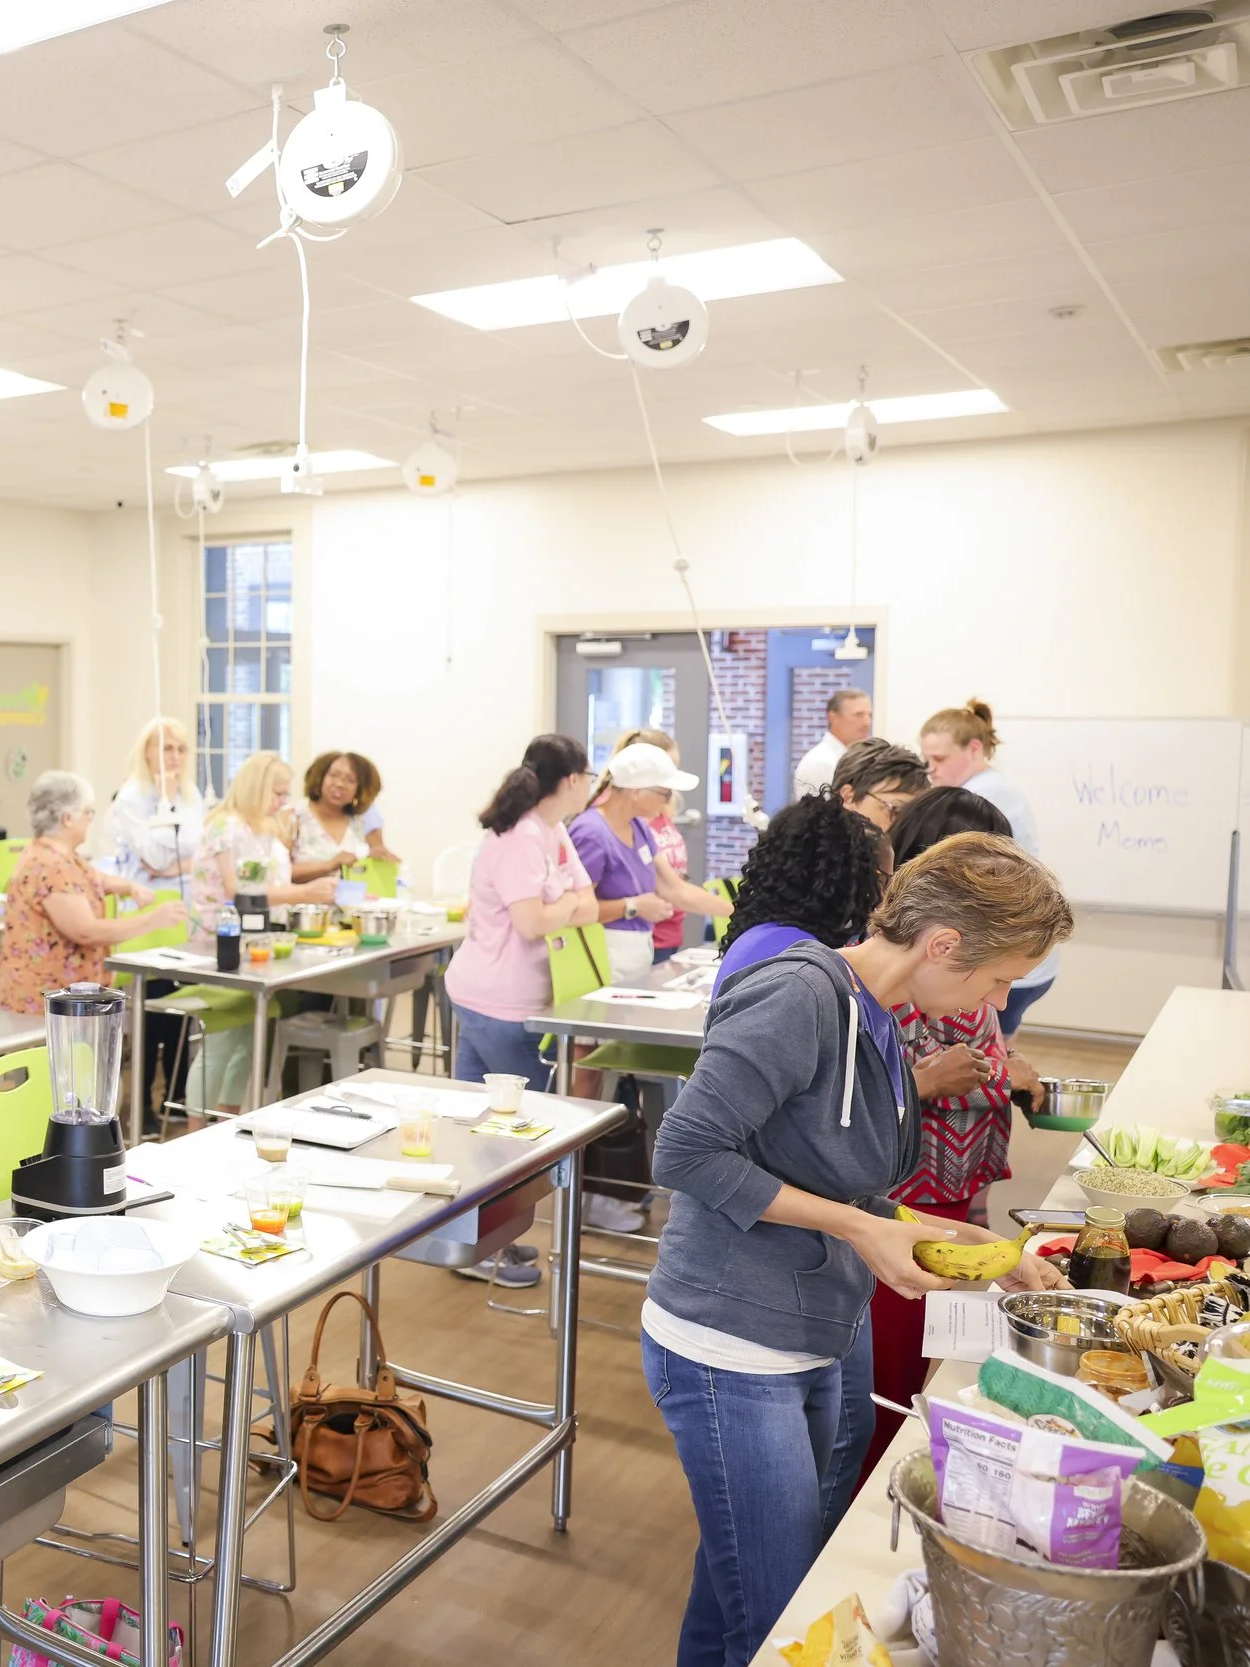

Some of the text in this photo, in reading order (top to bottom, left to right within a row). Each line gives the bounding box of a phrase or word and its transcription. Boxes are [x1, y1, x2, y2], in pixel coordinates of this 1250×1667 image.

[1070, 762, 1191, 808] Welcome
[943, 1419, 1018, 1452] Nutrition Facts
